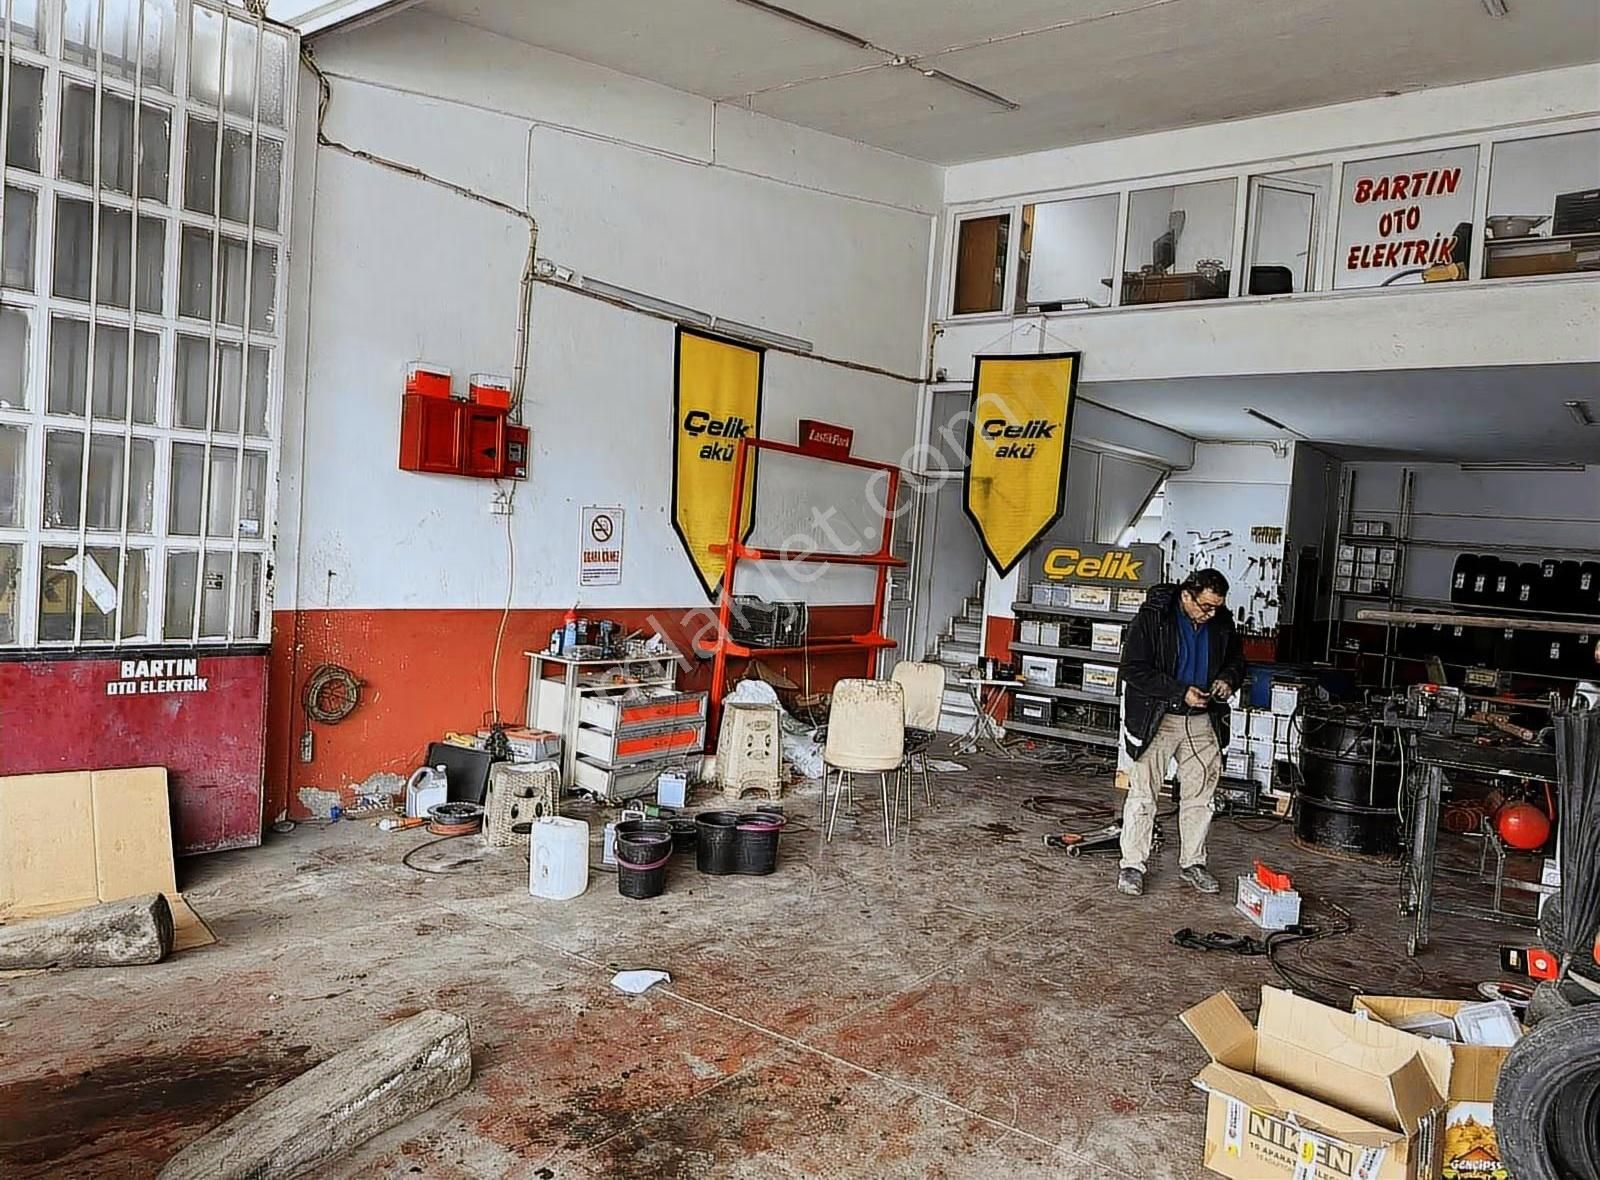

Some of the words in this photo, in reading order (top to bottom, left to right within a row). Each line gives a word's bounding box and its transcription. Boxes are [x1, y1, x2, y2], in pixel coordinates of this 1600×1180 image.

[1353, 168, 1461, 204] BARTIN
[1378, 205, 1420, 237] OTO
[1347, 232, 1457, 270] ELEKTRİK
[684, 410, 750, 439] Çelik
[982, 419, 1058, 441] Çelik
[699, 443, 735, 462] akü
[995, 443, 1036, 460] akü
[1042, 547, 1144, 581] Çelik
[121, 659, 197, 678] BARTIN
[107, 681, 136, 695] OTO
[140, 675, 208, 694] ELEKTRİK
